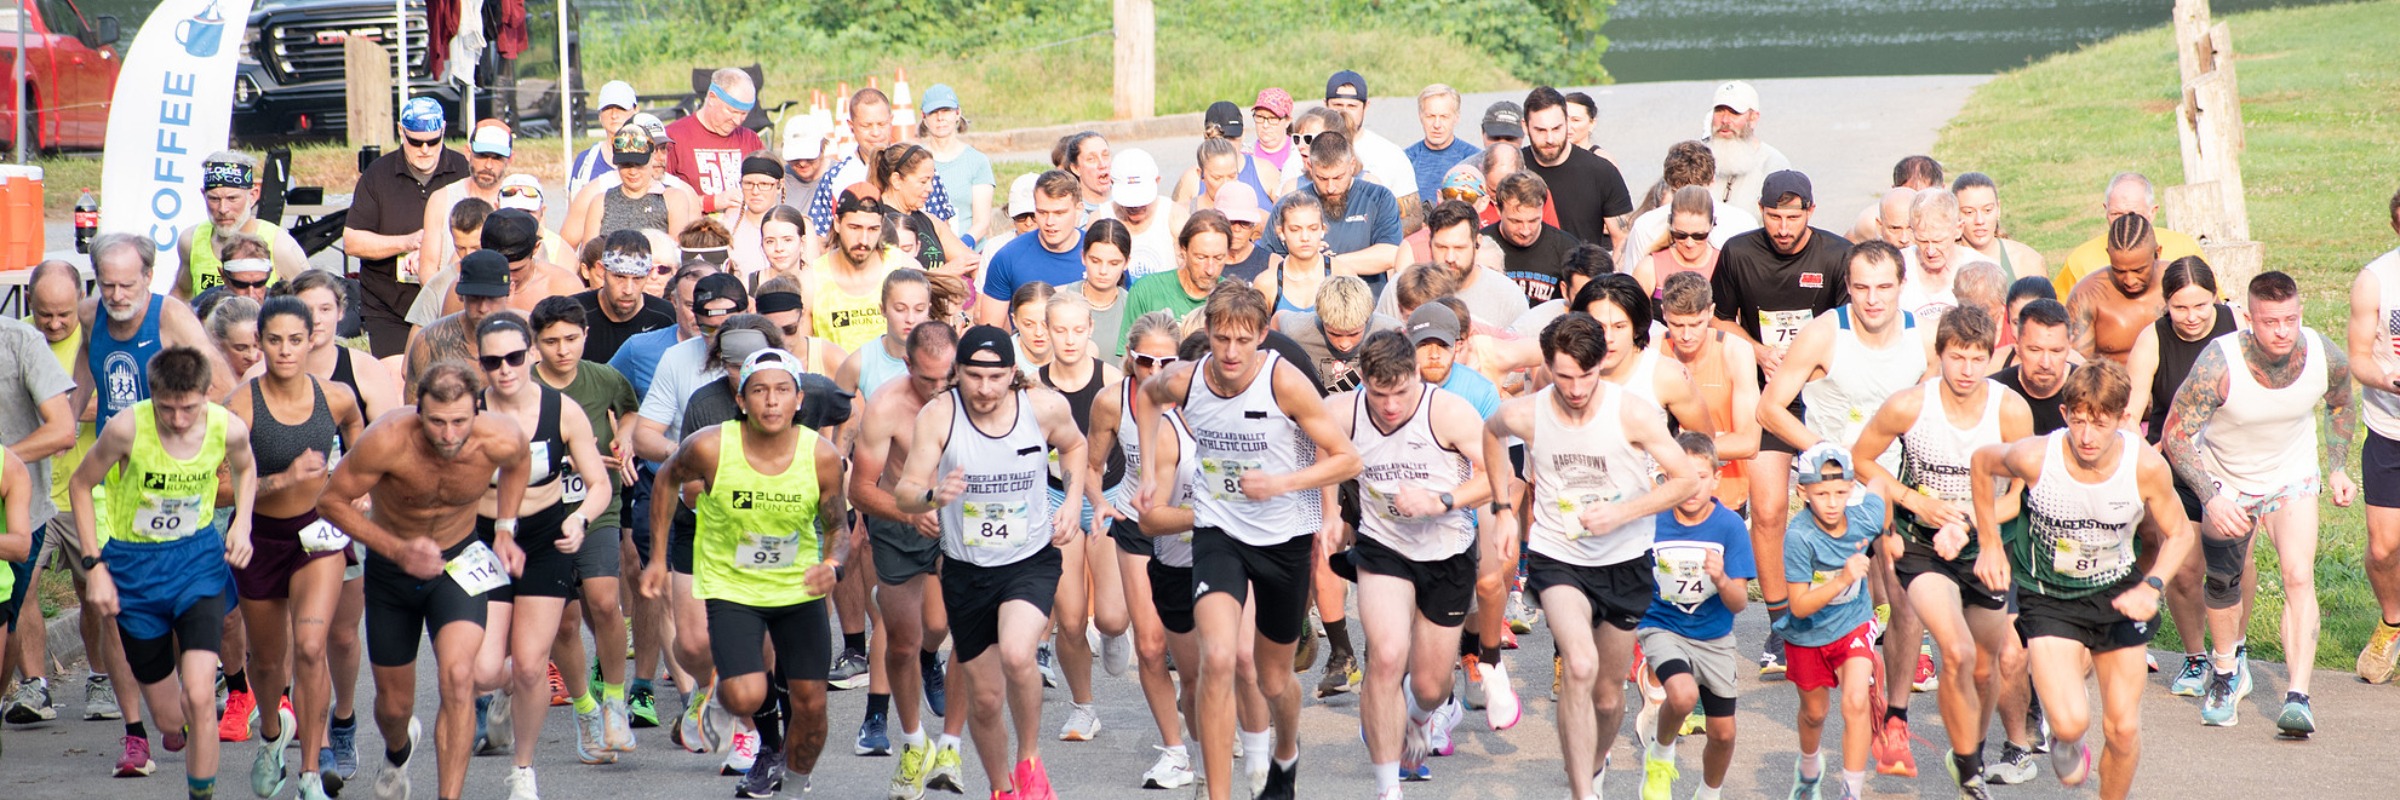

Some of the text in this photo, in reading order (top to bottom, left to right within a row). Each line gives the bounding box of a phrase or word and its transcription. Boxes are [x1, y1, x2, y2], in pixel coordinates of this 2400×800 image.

[152, 70, 195, 252] COFFEE
[1239, 432, 1266, 442] VALLEY
[1198, 438, 1268, 453] ATHLETIC CLUB
[562, 477, 584, 494] 10
[966, 483, 1009, 495] THLETIC
[755, 491, 802, 503] 2LOWE
[755, 502, 801, 513] RUN CO
[151, 516, 181, 530] 60
[980, 522, 1009, 540] 84
[753, 551, 781, 564] 93
[2075, 557, 2099, 572] 81
[468, 561, 499, 582] 114
[1675, 579, 1704, 595] 74
